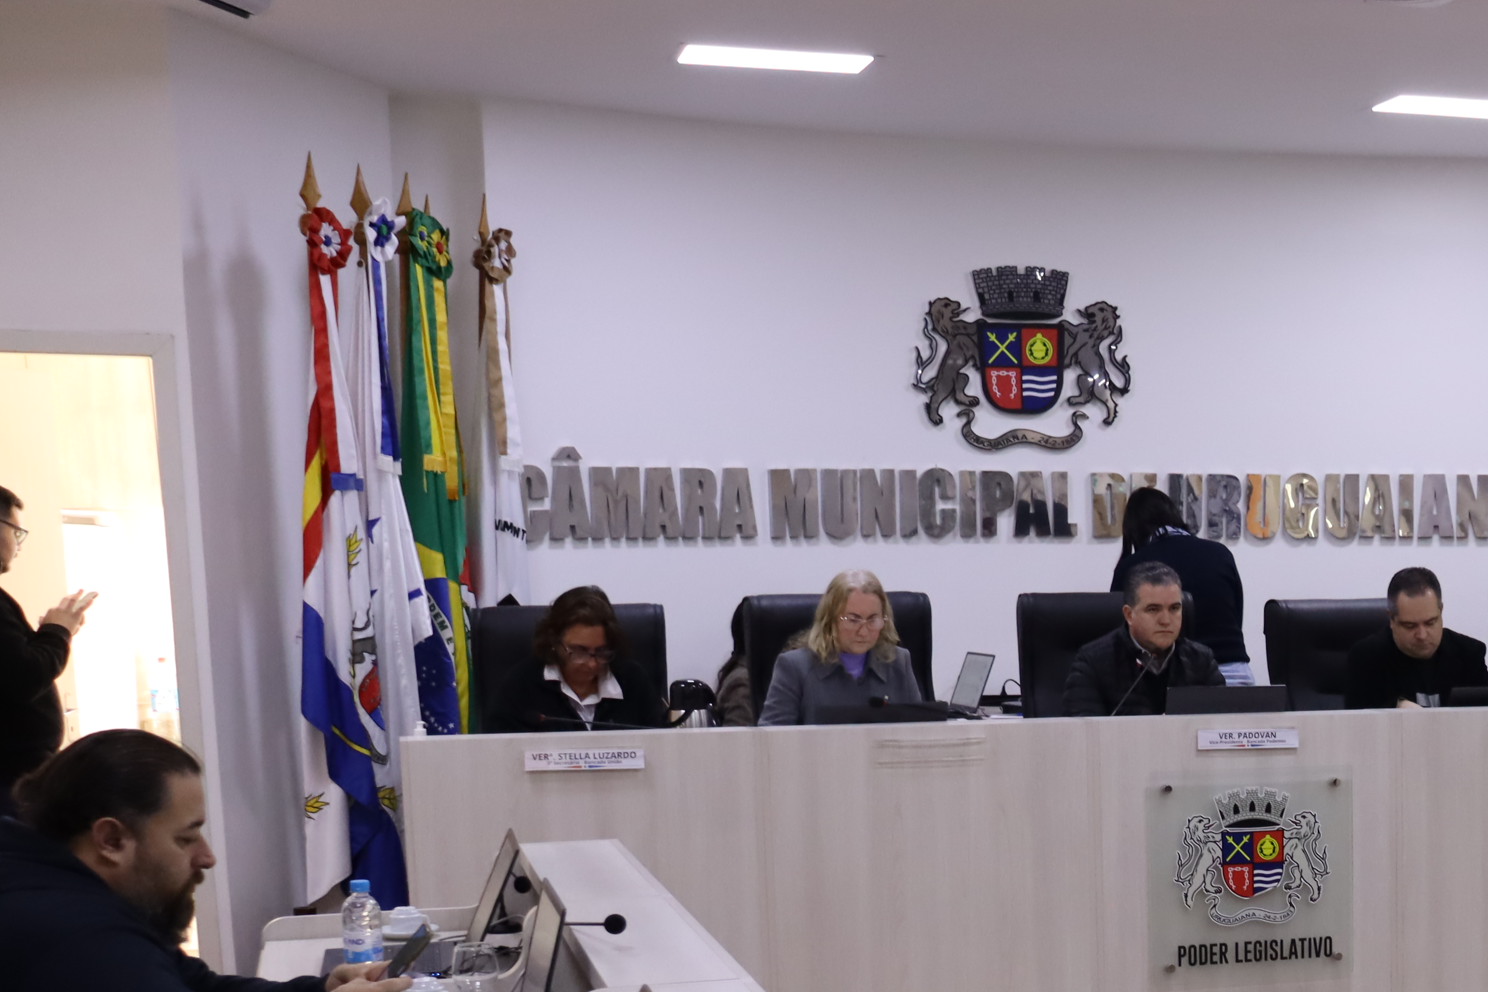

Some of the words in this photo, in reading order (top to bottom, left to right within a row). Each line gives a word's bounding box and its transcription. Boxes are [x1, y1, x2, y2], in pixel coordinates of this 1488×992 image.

[520, 446, 758, 541] CÂMARA
[768, 466, 1077, 541] MUNICIPAL
[1218, 732, 1236, 740] VER.
[1238, 731, 1277, 739] PADOVAN
[558, 752, 590, 761] STELLA
[593, 751, 637, 760] LUZARDO
[1177, 942, 1229, 967] PODER
[1235, 936, 1333, 963] LEGISLATIVO
